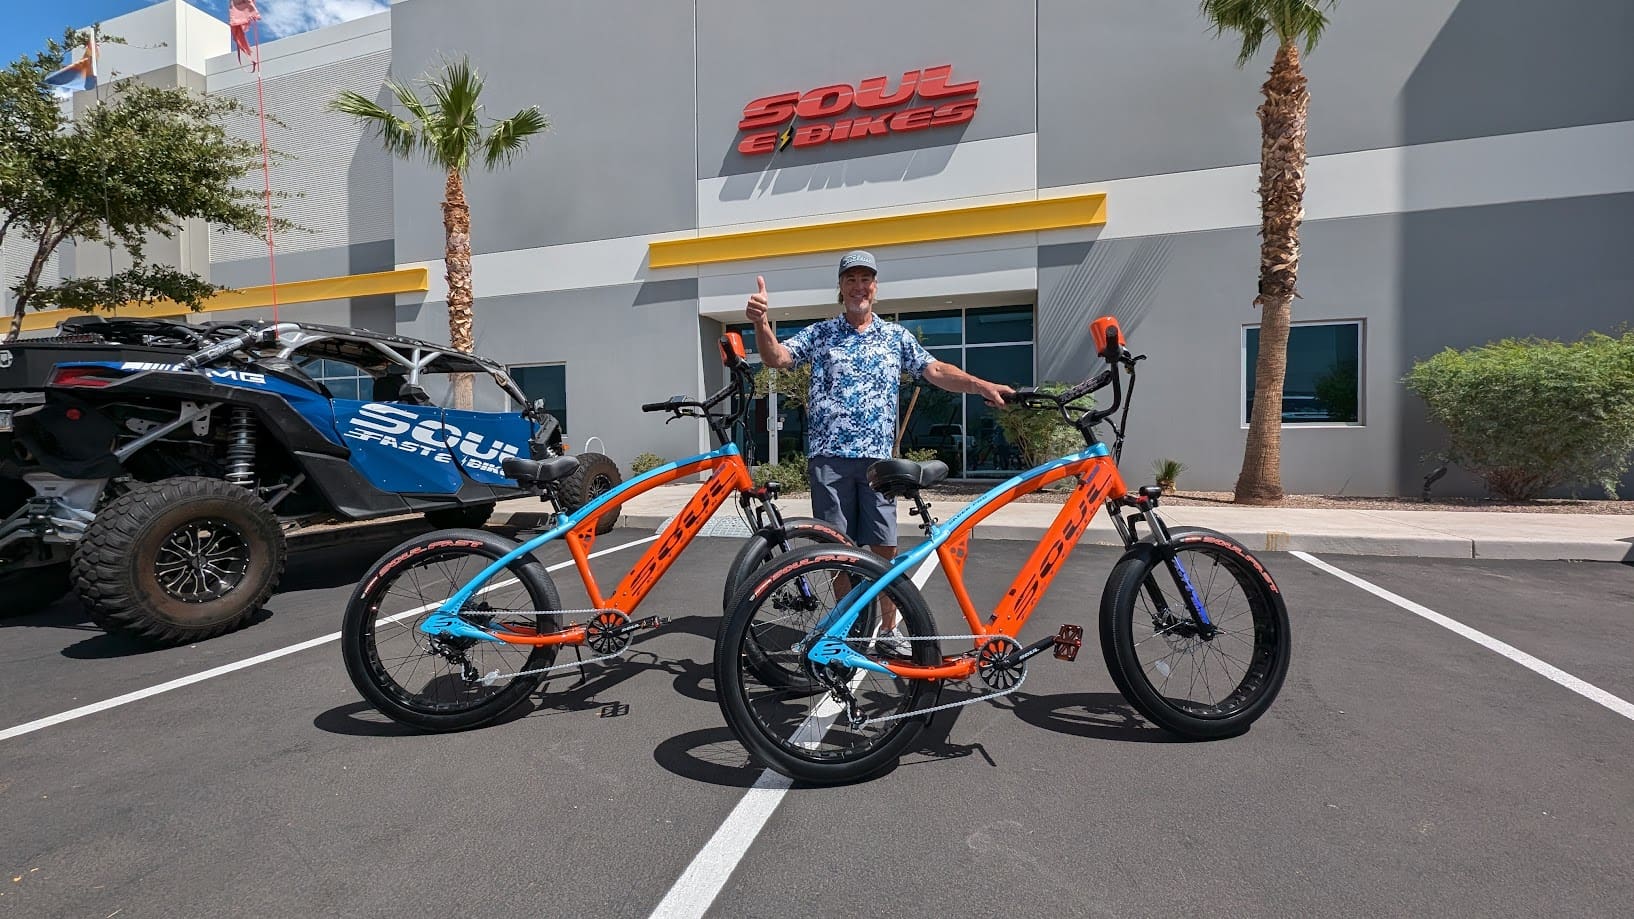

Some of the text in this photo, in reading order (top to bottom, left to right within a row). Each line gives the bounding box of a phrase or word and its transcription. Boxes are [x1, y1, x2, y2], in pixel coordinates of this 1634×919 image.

[737, 98, 979, 155] E BIKES
[738, 64, 979, 130] SOUL
[466, 458, 505, 477] BIK
[630, 471, 737, 597] SOUL
[1013, 473, 1112, 621] SOUL
